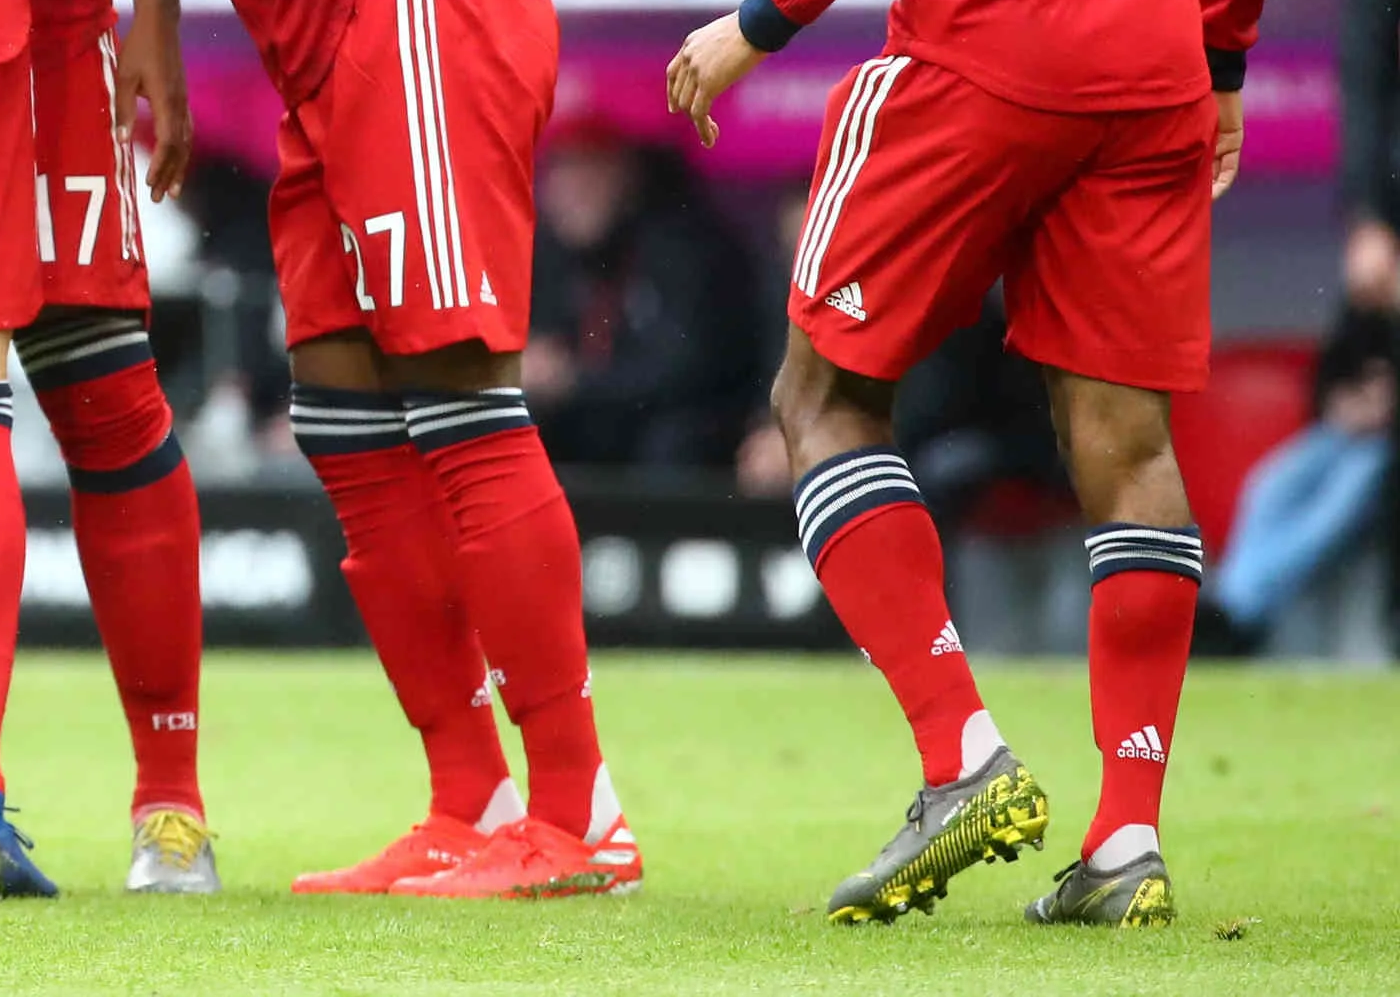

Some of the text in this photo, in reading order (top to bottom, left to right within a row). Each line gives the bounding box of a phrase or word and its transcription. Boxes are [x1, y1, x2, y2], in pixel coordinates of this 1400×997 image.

[35, 172, 107, 266] 17
[340, 211, 406, 312] 27
[151, 711, 196, 731] FCB
[1116, 746, 1167, 764] adidas
